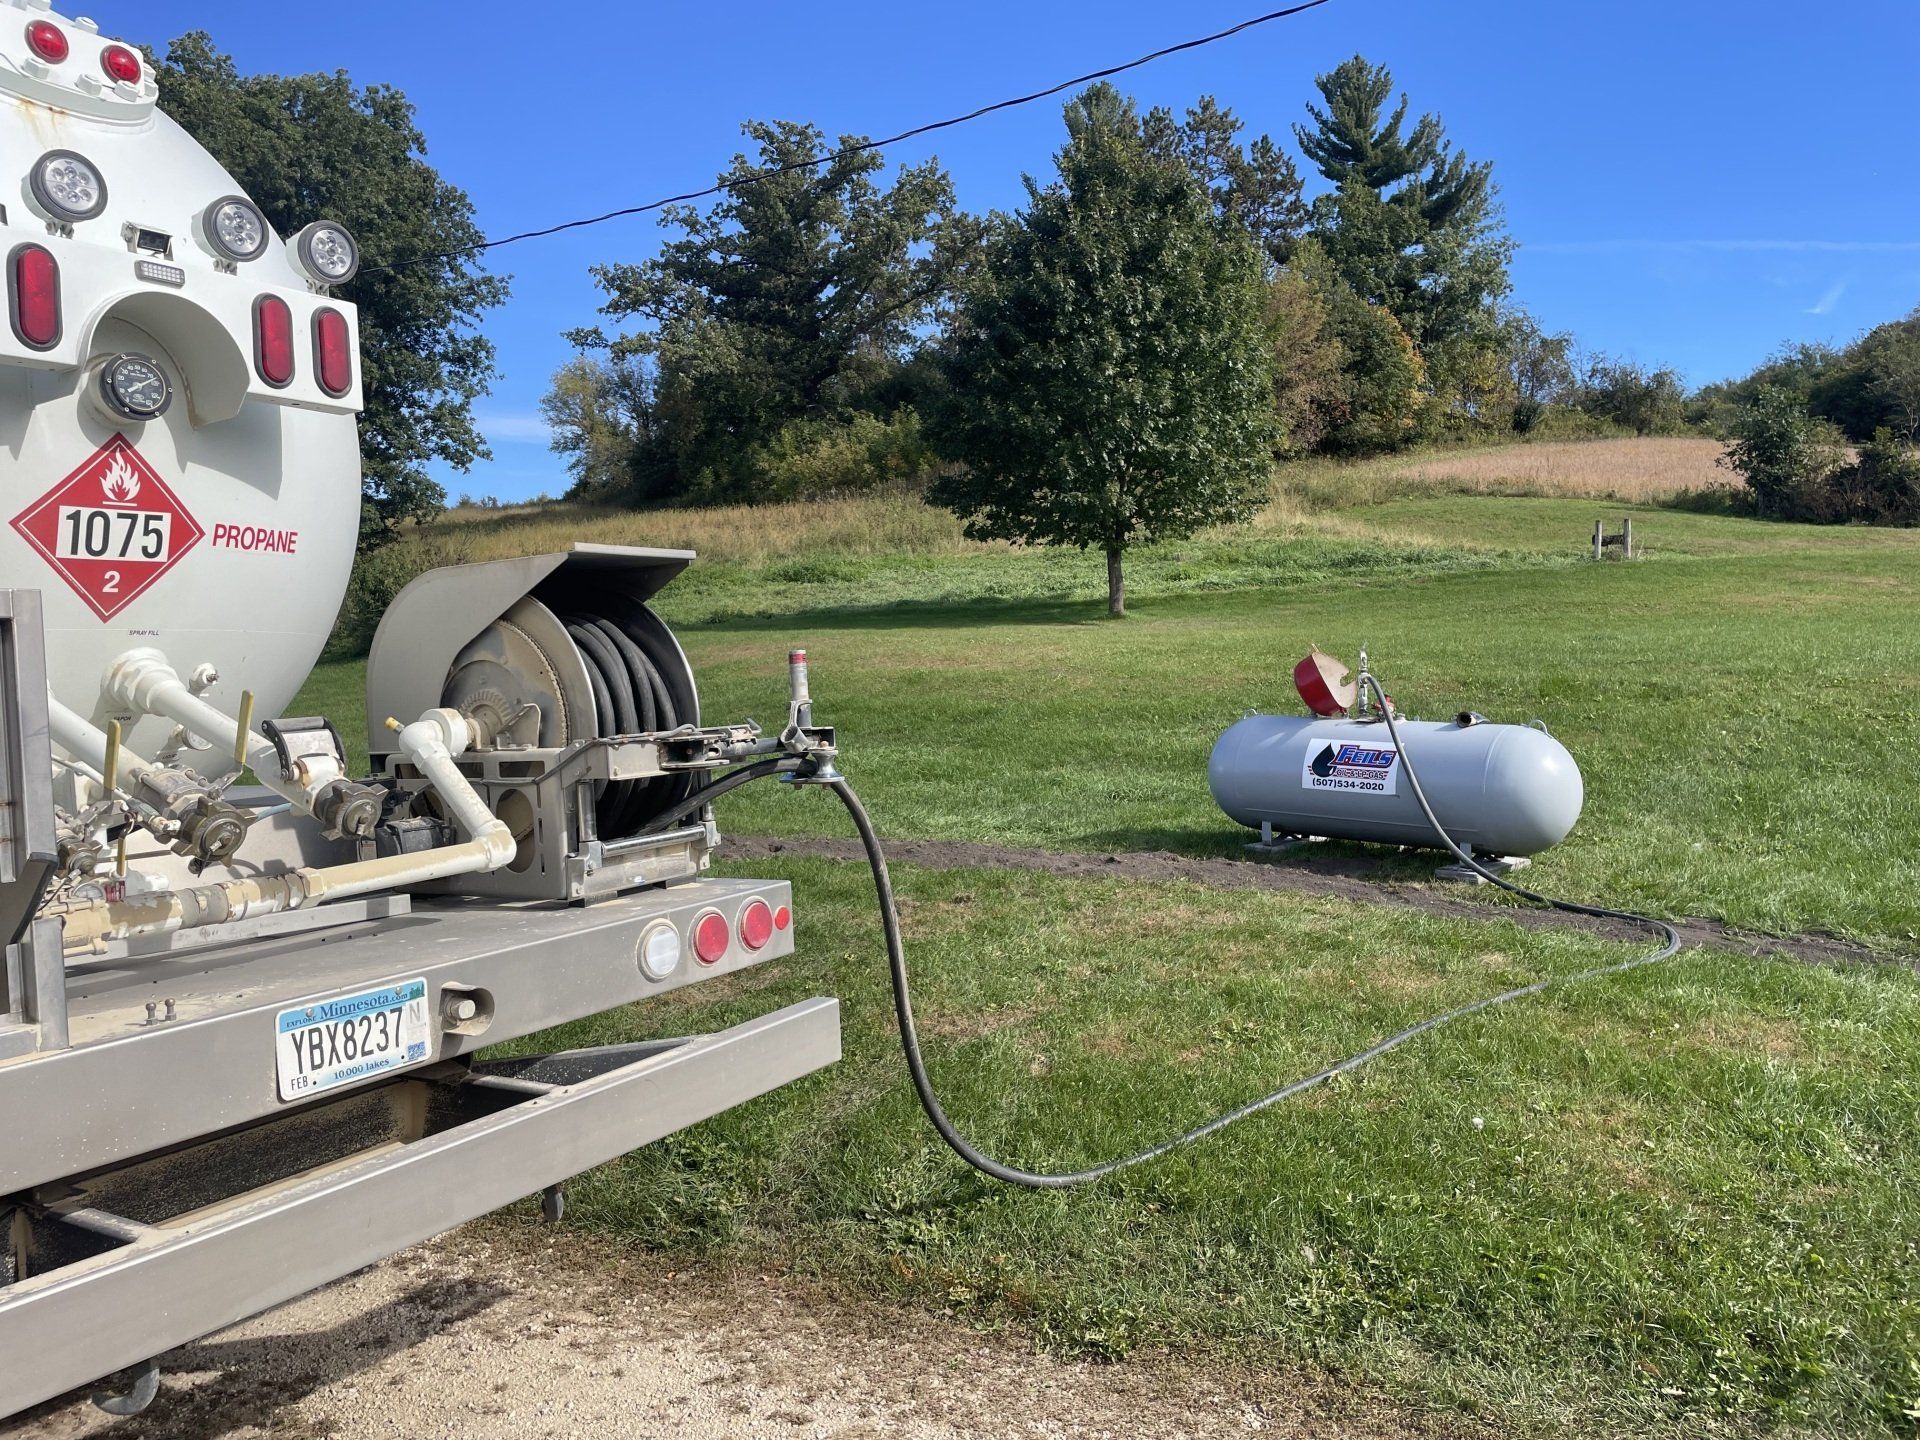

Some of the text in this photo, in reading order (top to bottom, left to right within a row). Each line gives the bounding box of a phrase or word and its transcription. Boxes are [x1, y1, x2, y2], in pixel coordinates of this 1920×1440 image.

[65, 508, 164, 559] 1075
[212, 523, 299, 554] PROPANE
[101, 569, 121, 593] 2
[1336, 746, 1394, 766] FEILS
[1312, 777, 1384, 791] (507)534-2020
[1368, 771, 1384, 780] GAS
[291, 1006, 402, 1074] YBX8237
[365, 1058, 390, 1071] lakes
[290, 1075, 309, 1091] FEB
